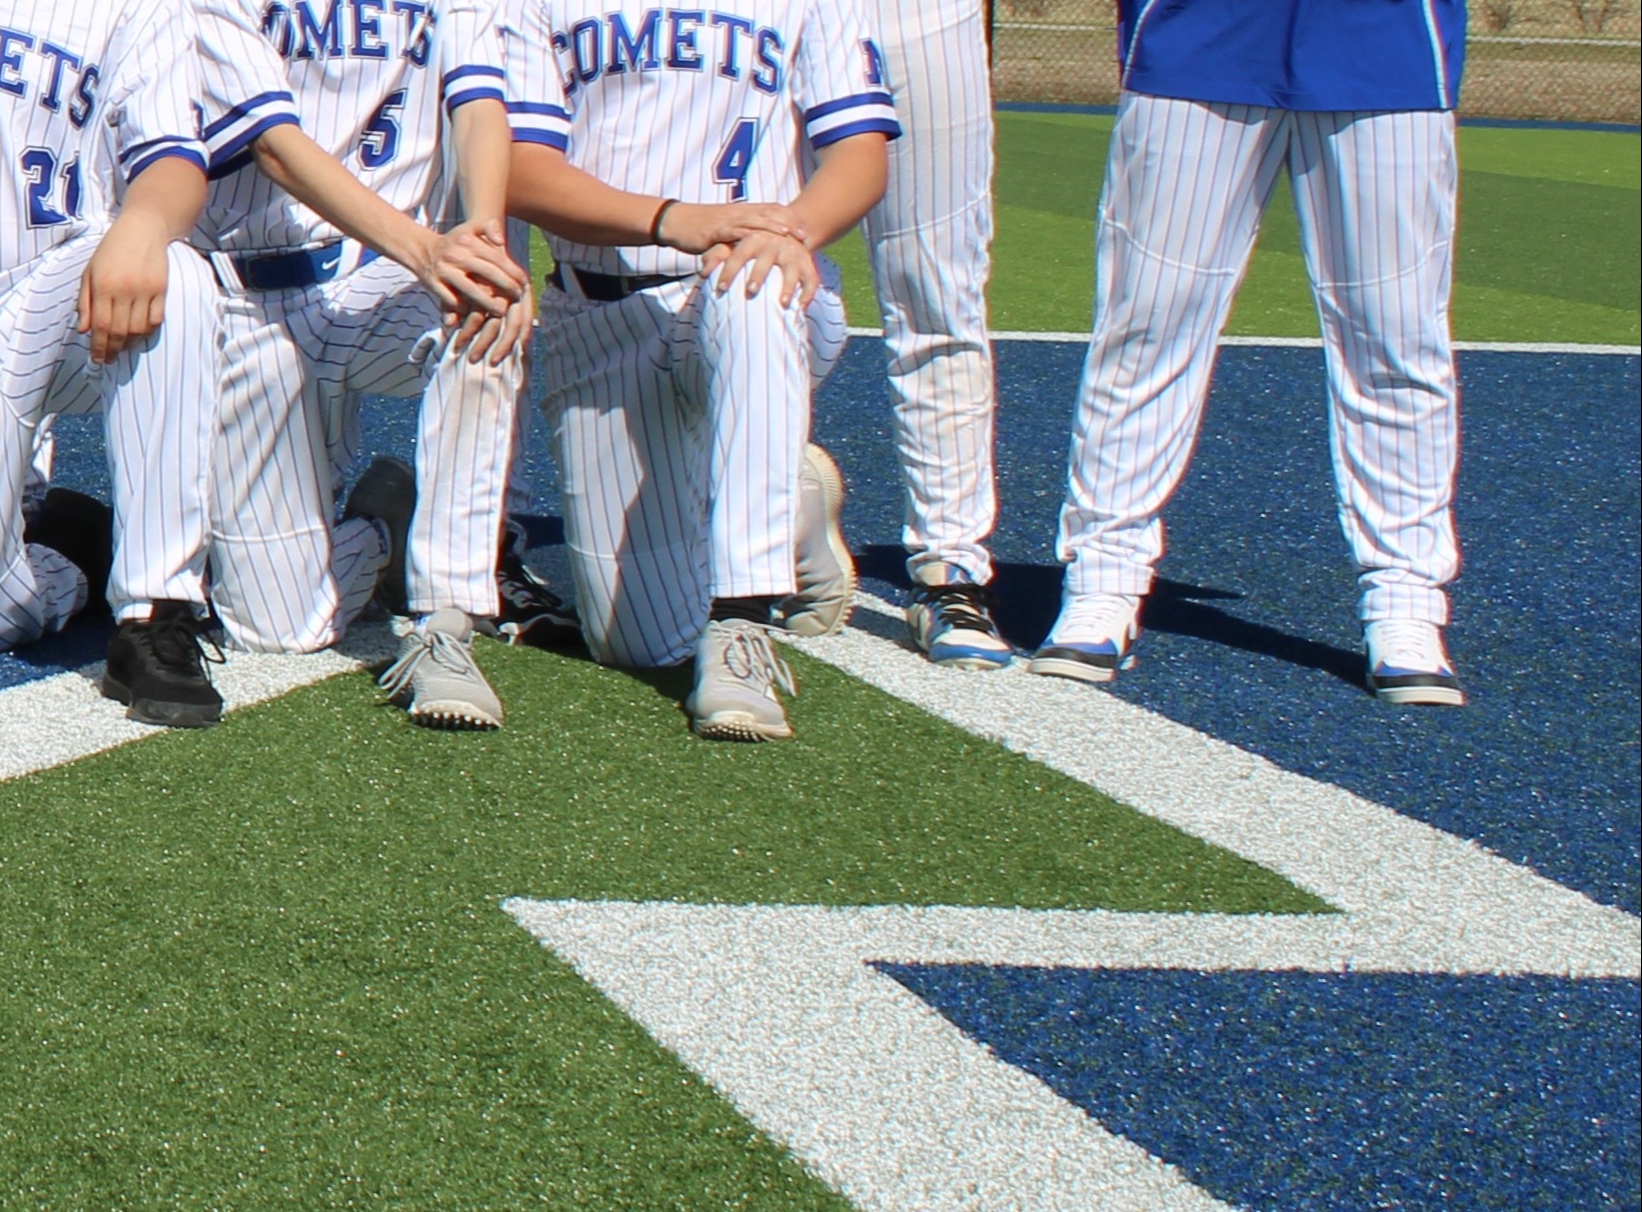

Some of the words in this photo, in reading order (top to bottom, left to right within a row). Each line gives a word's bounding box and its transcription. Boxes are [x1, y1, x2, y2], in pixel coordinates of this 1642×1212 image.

[553, 9, 783, 95] COMETS
[359, 90, 408, 169] 5
[711, 118, 758, 200] 4
